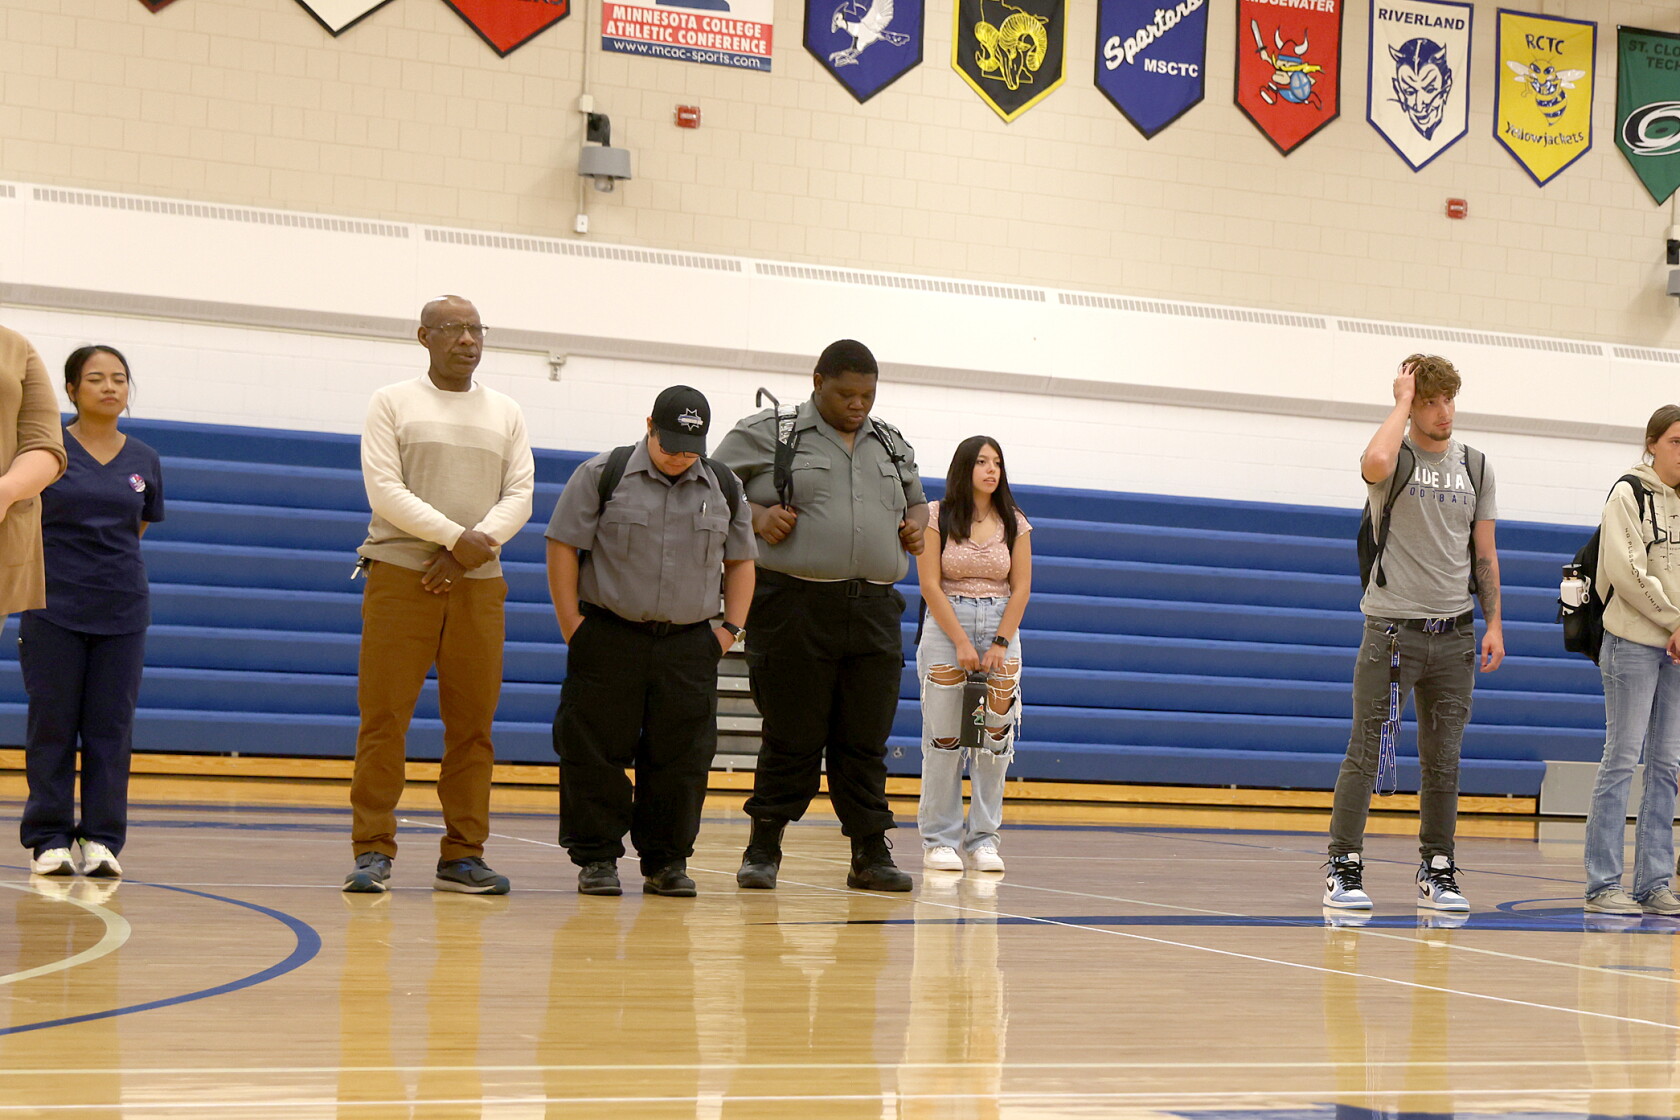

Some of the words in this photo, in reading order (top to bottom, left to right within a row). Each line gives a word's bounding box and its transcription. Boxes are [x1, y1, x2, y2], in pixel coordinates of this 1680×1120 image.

[1245, 0, 1335, 13] EWATER
[612, 5, 698, 30] MINNESOTA
[702, 16, 762, 38] COLLEGE
[1378, 8, 1465, 31] RIVERLAND
[606, 20, 673, 42] ATHLETIC
[677, 29, 767, 54] CONFERENCE
[1525, 33, 1565, 55] RCTC
[1628, 39, 1648, 53] ST.
[613, 40, 761, 68] www.mcac-sports.com
[1144, 58, 1199, 77] MSCTC
[1414, 466, 1440, 488] LUE
[1444, 472, 1476, 492] JA
[1409, 486, 1475, 505] OOTBAL
